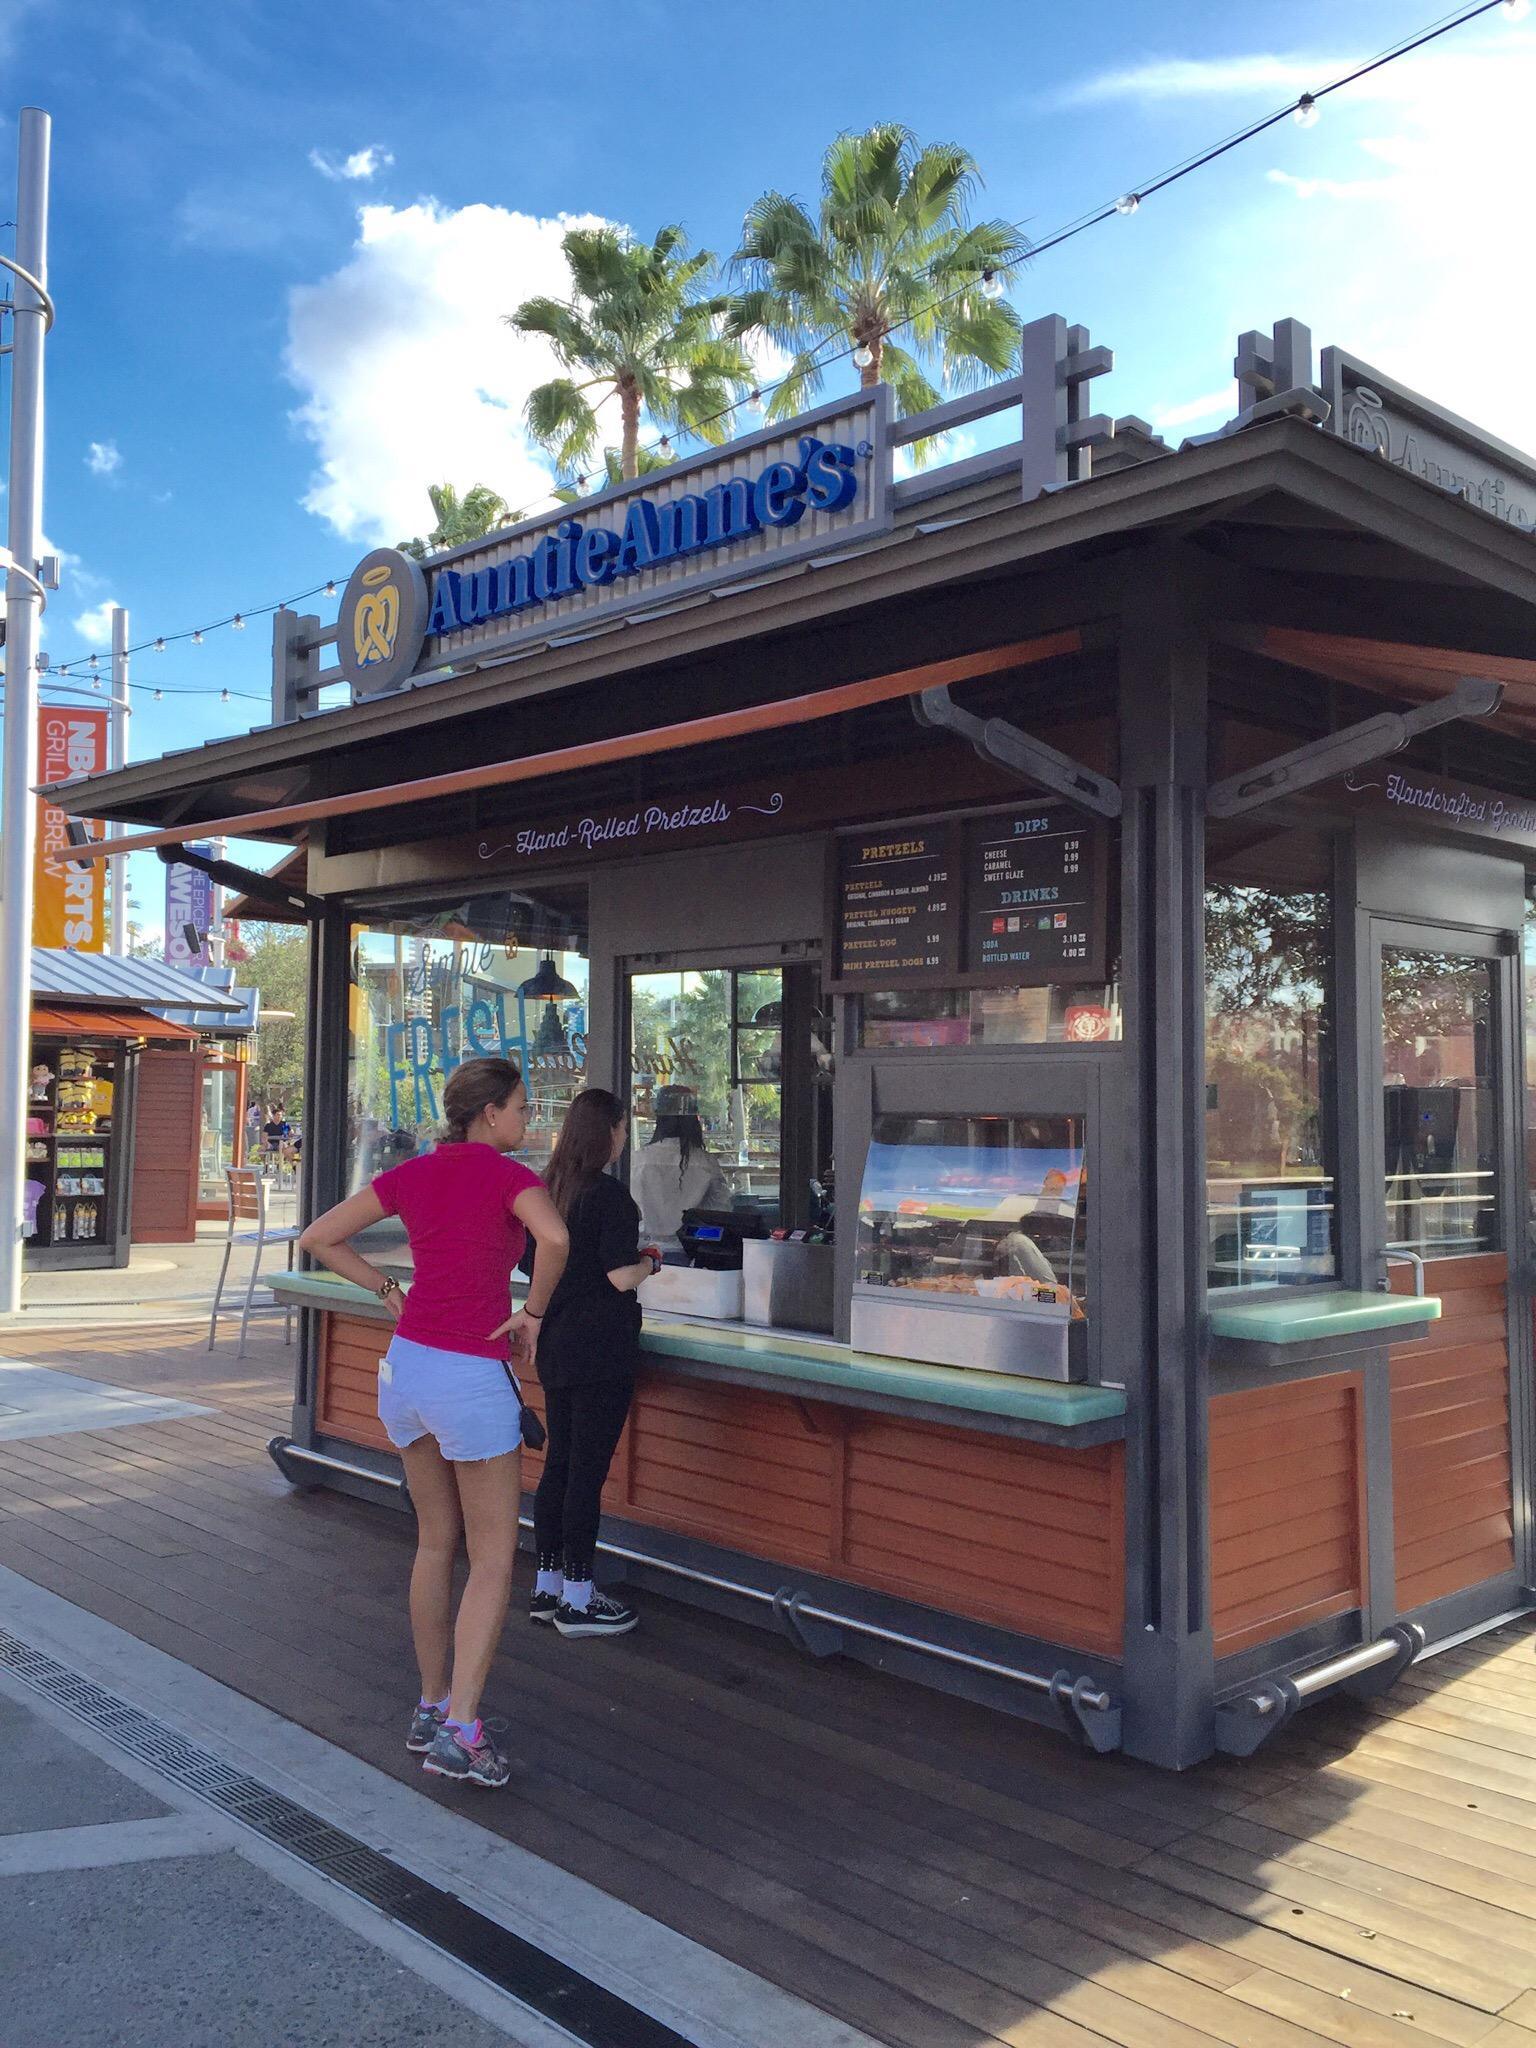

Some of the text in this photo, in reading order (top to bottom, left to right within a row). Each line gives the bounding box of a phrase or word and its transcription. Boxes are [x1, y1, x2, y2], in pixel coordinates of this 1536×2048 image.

[1386, 774, 1487, 824] Handcrafted
[644, 800, 731, 834] Pretzels
[1014, 818, 1048, 834] DIPS
[862, 841, 925, 860] PRETZELS
[984, 841, 1079, 860] CHEESE 0.99
[984, 852, 1079, 871] CARAMEL 0.99
[983, 864, 1079, 882] SWEET GLAZE 0.99
[844, 881, 882, 892] PRETZELS
[1000, 886, 1059, 904] DRINKS
[844, 910, 878, 920] PRETZEL
[880, 906, 917, 916] NUGGETS
[843, 940, 877, 950] PRETZEL
[879, 938, 897, 947] DOG
[982, 940, 999, 949] SODA
[842, 962, 863, 970] MINI
[865, 959, 900, 969] PRETZEL
[902, 957, 924, 967] DOGS
[982, 953, 1008, 963] BOTTLED
[1009, 951, 1030, 961] WATER
[410, 938, 496, 996] Simple
[387, 983, 531, 1131] FRESH
